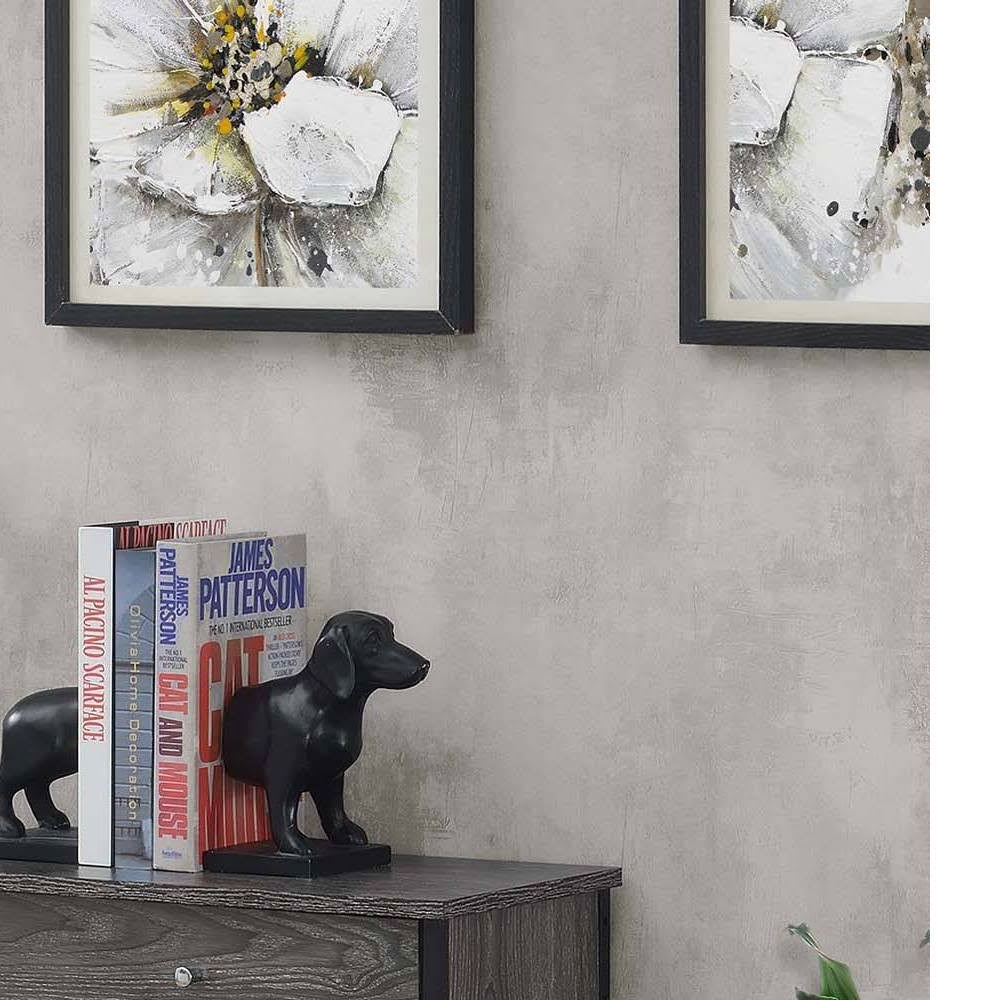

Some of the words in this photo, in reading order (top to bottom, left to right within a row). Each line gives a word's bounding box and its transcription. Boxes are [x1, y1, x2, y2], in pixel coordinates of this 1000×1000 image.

[228, 538, 273, 574] JAMES
[83, 575, 105, 596] AL
[159, 548, 177, 645] PATTERSON
[176, 576, 189, 617] JAMES
[199, 566, 305, 621] PATTERSON
[83, 598, 105, 659] PACINO
[82, 663, 105, 742] SCARFACE
[129, 661, 140, 711] Home
[158, 673, 189, 716] CAT
[158, 716, 183, 757] AND
[128, 719, 140, 820] Decoration
[158, 762, 188, 841] MOUSE
